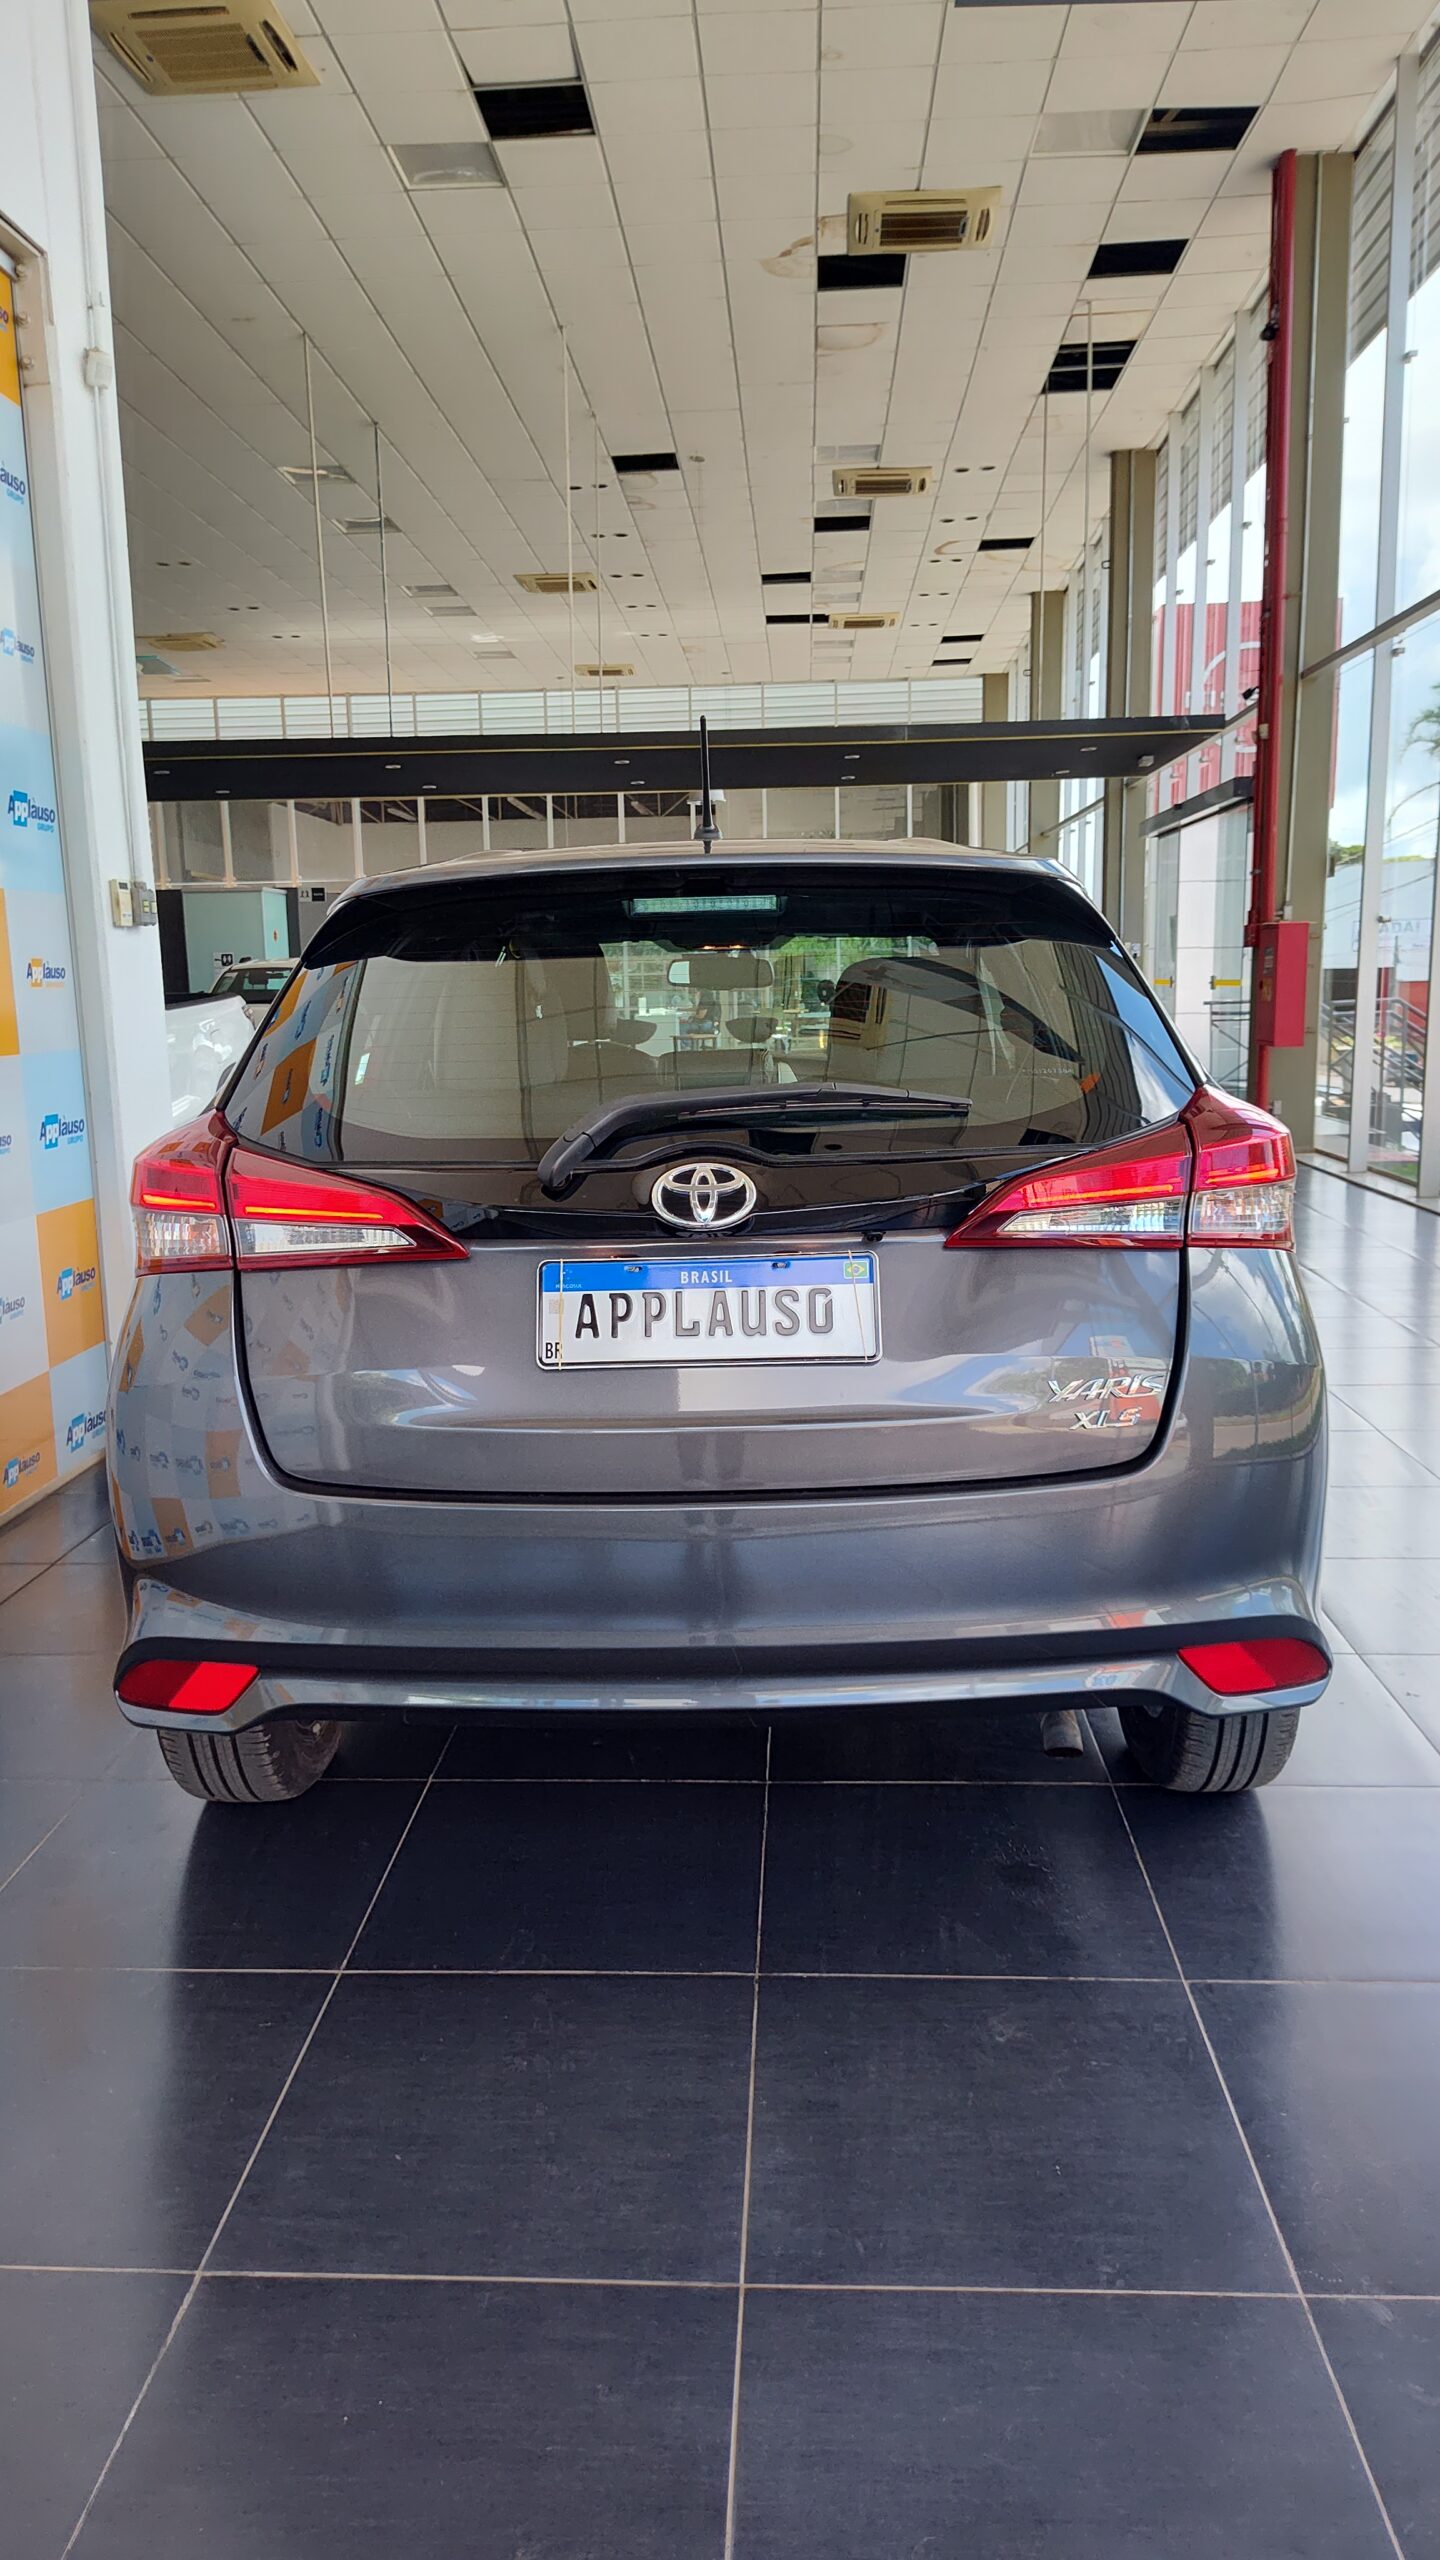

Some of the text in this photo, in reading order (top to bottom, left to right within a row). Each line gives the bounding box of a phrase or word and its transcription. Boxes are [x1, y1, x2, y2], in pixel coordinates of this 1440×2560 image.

[680, 1270, 733, 1284] BRASIL
[574, 1287, 834, 1339] APPLAUSO
[1048, 1374, 1165, 1403] YARIS
[1068, 1406, 1142, 1430] XLS
